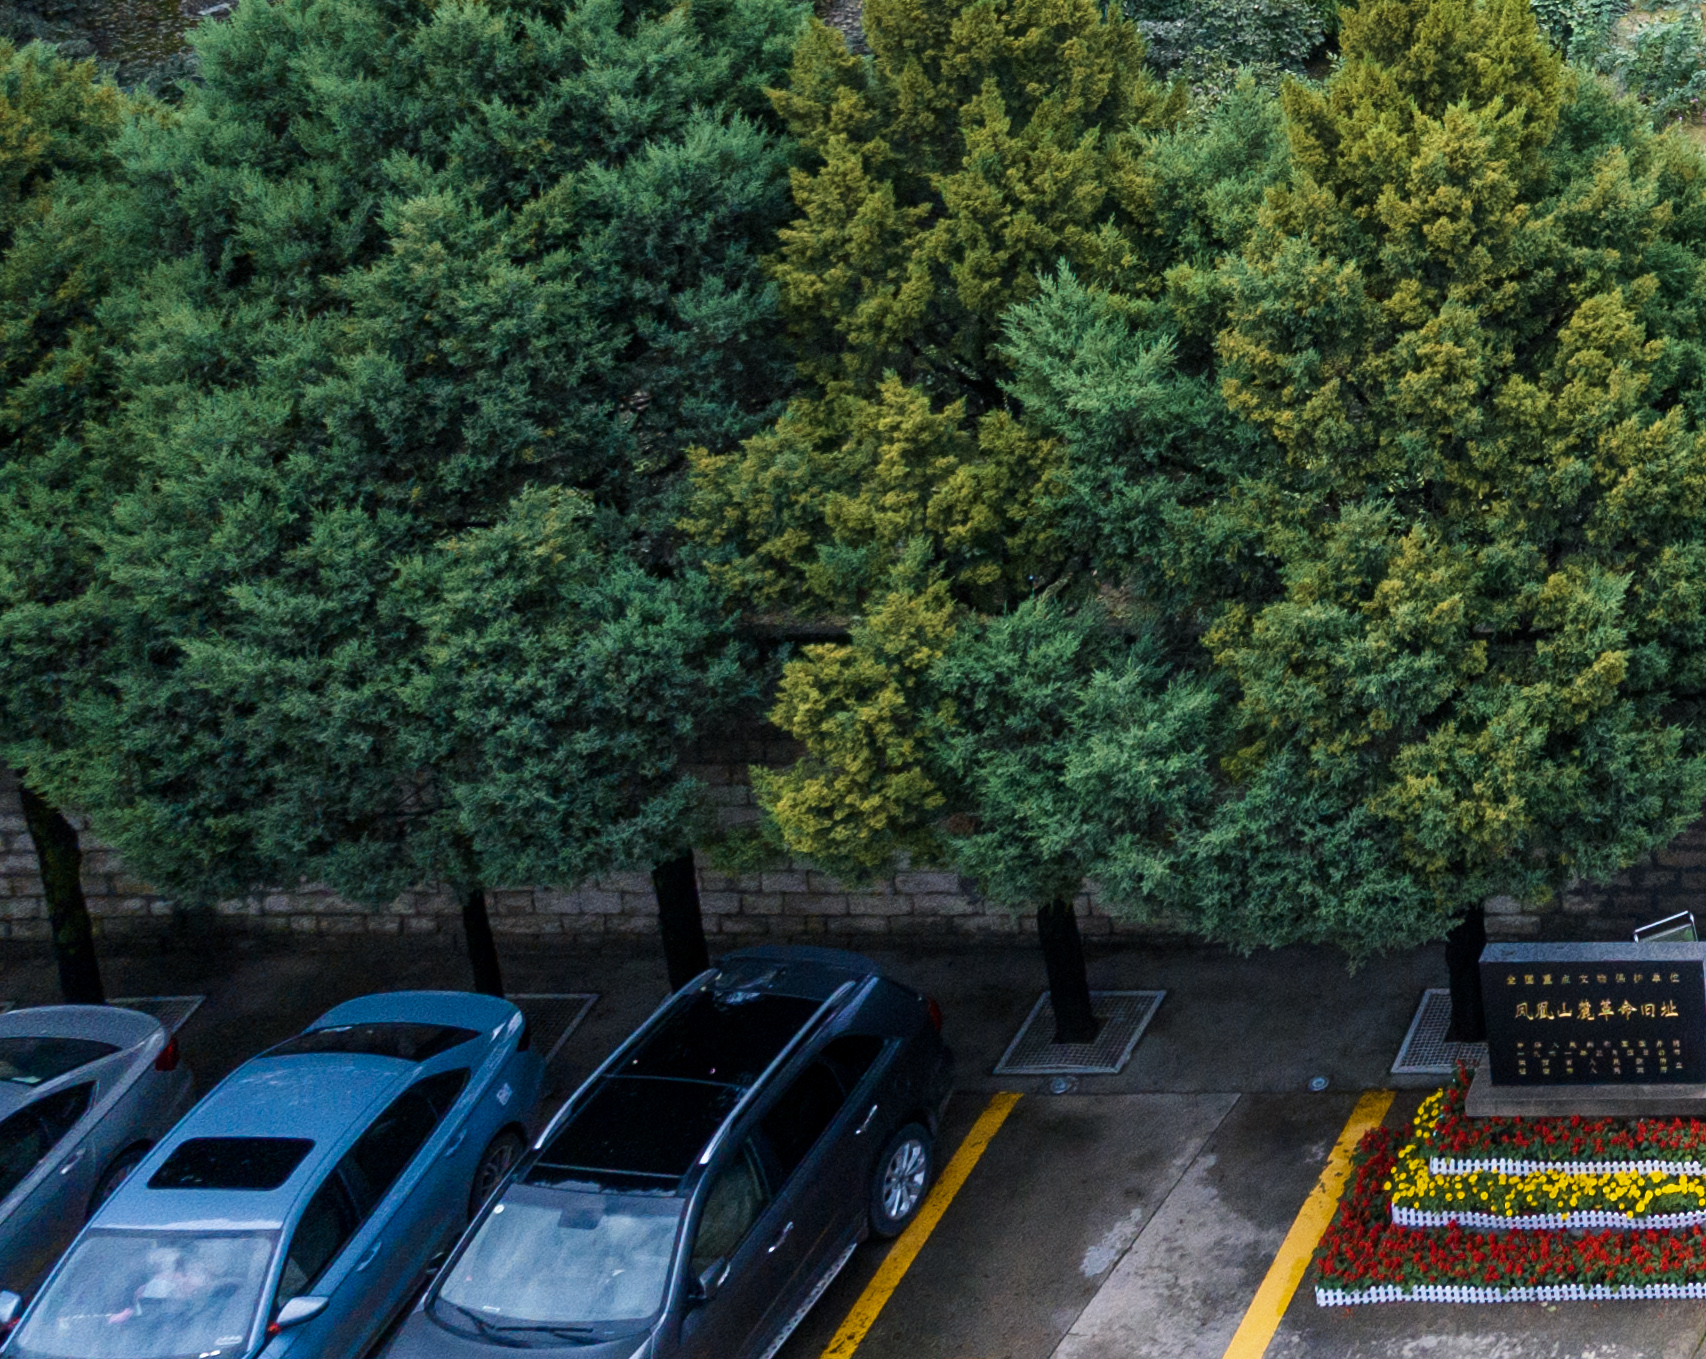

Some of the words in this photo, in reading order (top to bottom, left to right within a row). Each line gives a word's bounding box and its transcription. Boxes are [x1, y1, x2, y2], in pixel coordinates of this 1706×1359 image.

[1507, 973, 1680, 985] 全国重点文物保护单位
[1514, 998, 1680, 1022] 凤凰山麓革命旧址
